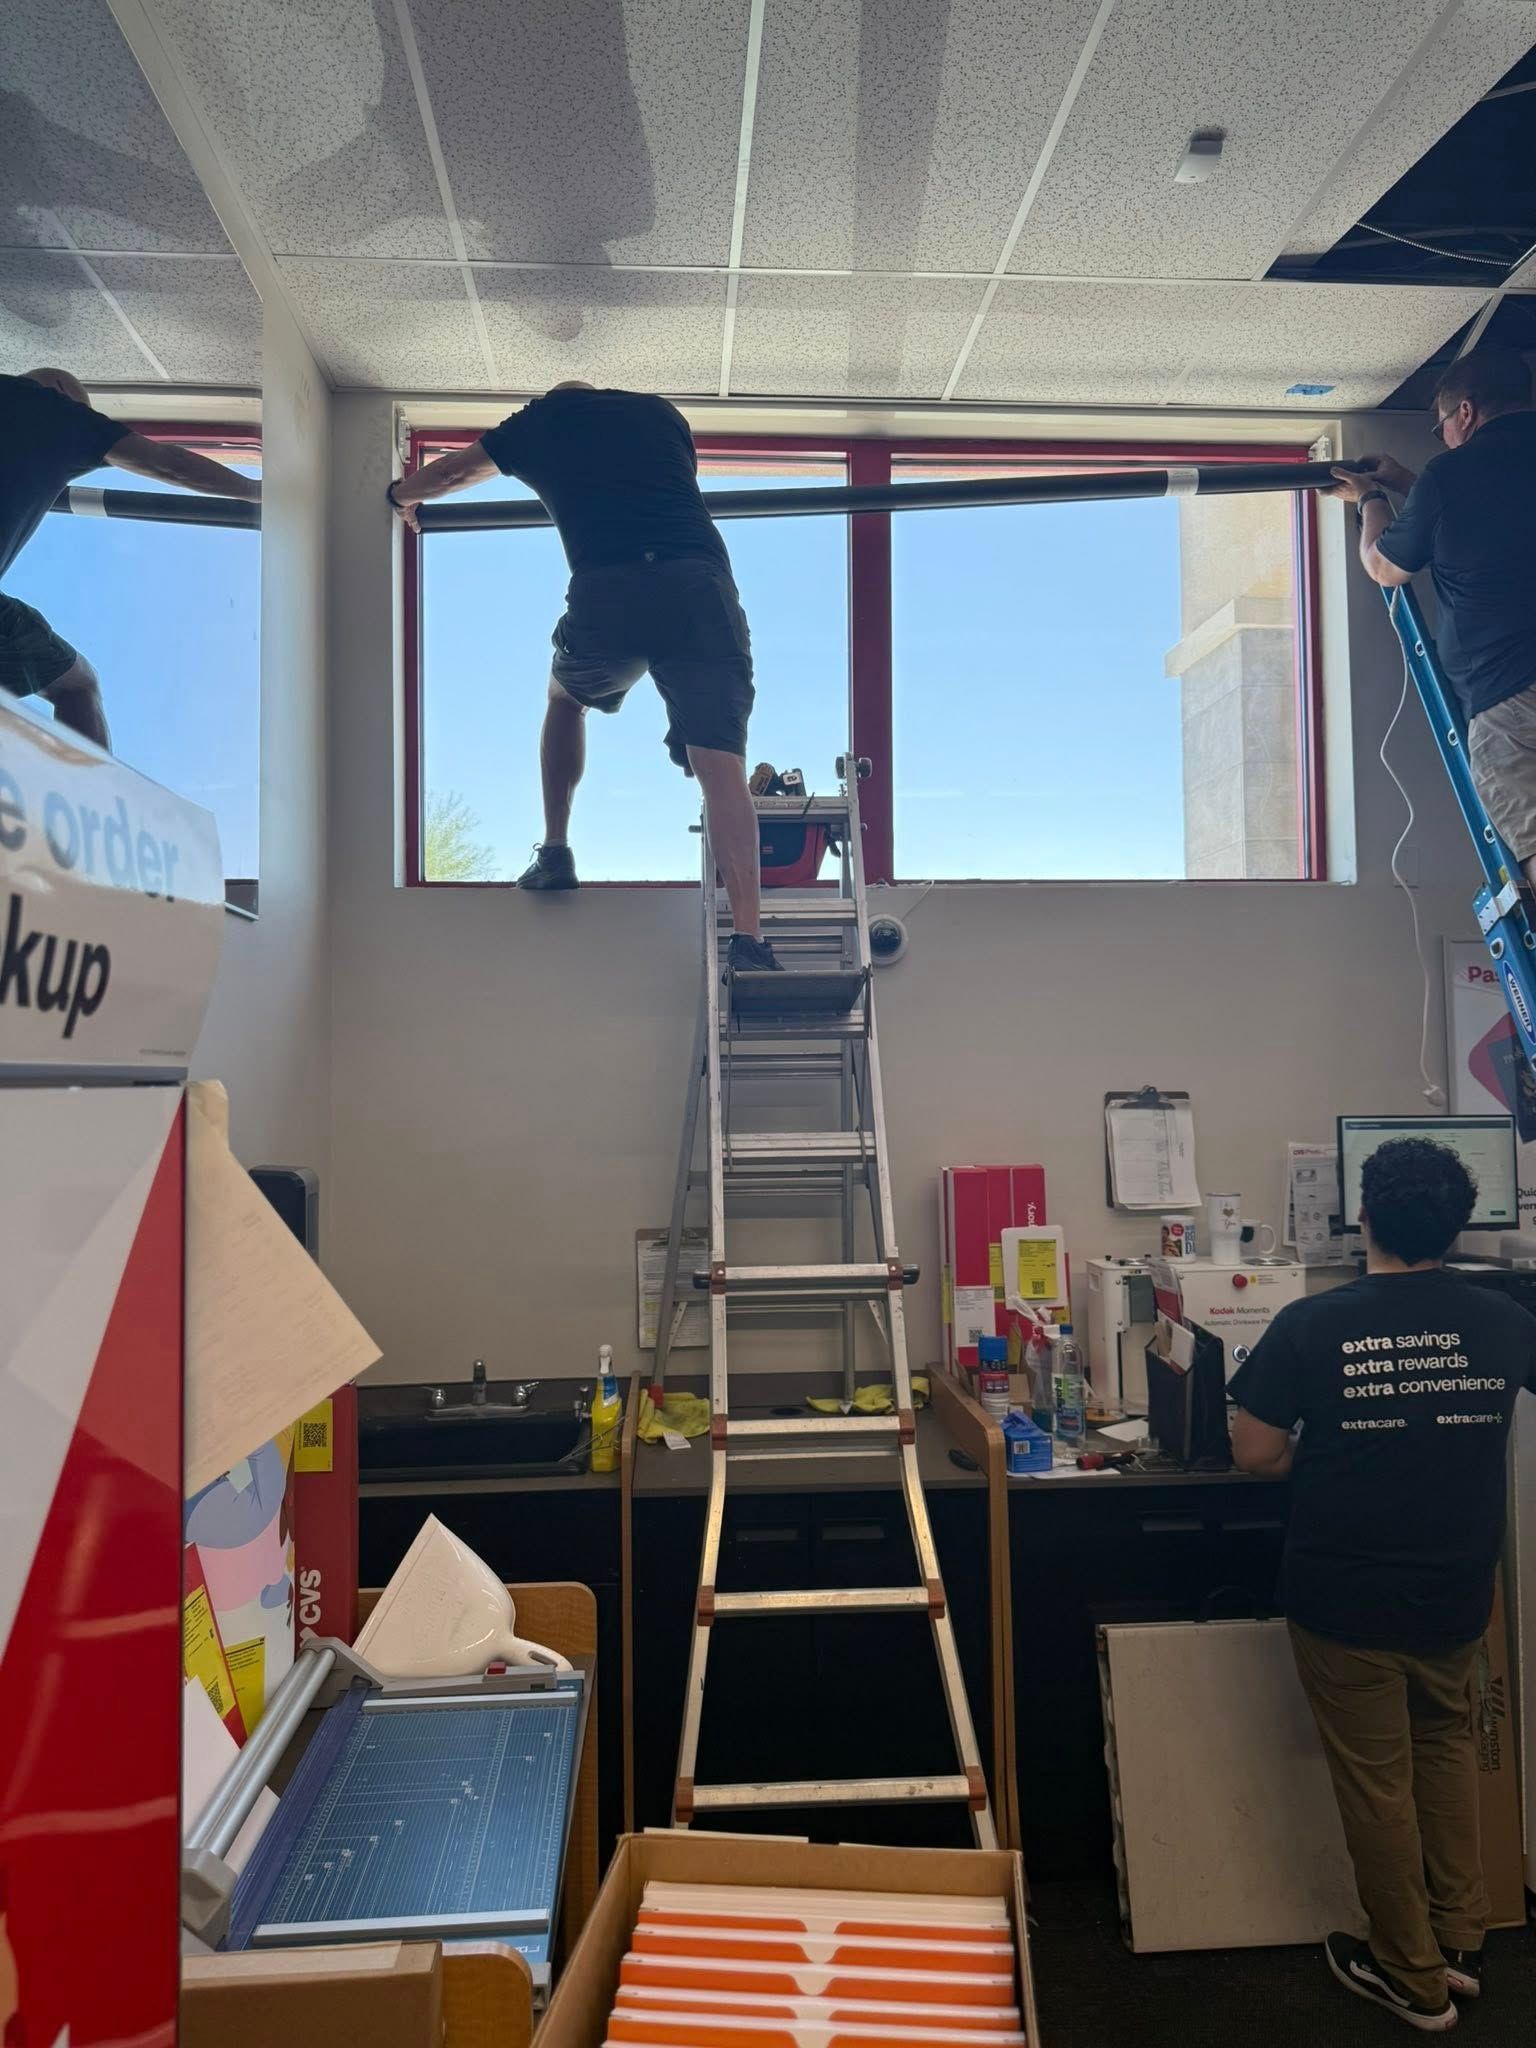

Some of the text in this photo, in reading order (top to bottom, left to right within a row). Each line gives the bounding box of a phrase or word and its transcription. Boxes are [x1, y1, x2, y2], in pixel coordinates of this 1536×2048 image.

[43, 790, 179, 902] order
[1510, 978, 1532, 1027] WERNER
[1209, 1306, 1271, 1315] Kodak Moments
[1341, 1330, 1461, 1354] extra savings
[1343, 1352, 1469, 1377] extra rewards
[1343, 1374, 1506, 1399] extra convenience
[299, 1569, 321, 1625] CVS
[1488, 1716, 1501, 1771] winston
